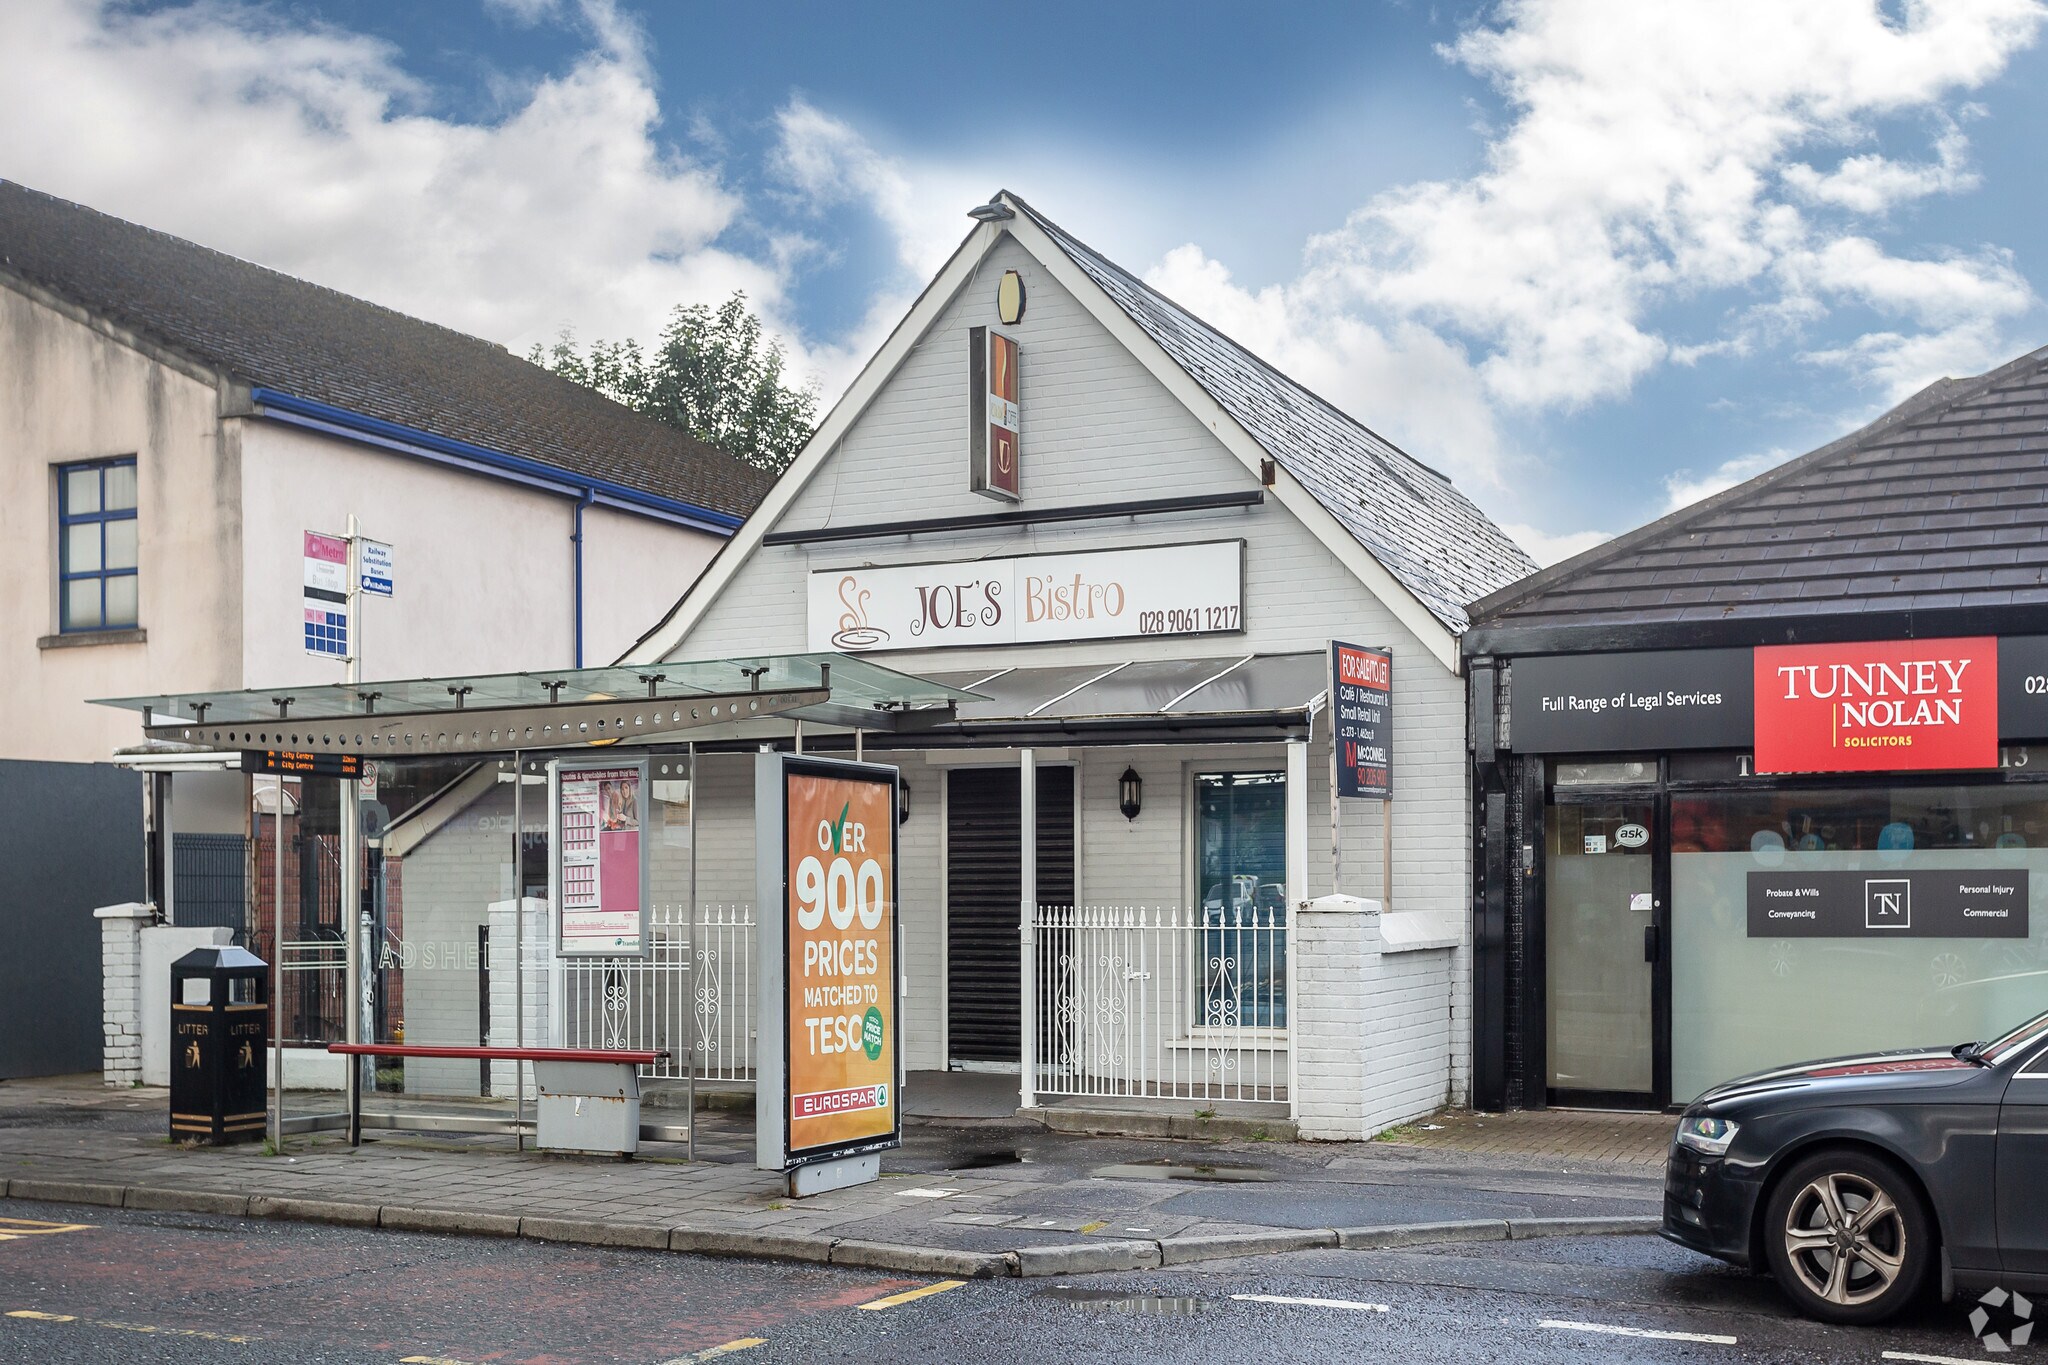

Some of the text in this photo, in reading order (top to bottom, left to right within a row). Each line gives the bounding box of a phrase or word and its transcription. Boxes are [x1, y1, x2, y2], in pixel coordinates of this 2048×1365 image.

[322, 545, 344, 560] Metro
[368, 547, 386, 558] Railway
[363, 556, 391, 568] Substitution
[370, 567, 384, 576] Buses
[910, 573, 1125, 637] JOE'S Bistro
[1139, 605, 1239, 634] 028 9061 1217
[1342, 654, 1356, 678] FOR
[1379, 662, 1387, 684] LET
[1777, 659, 1971, 699] TUNNEY
[2025, 675, 2048, 694] 02
[1340, 685, 1355, 701] Café
[1360, 689, 1384, 706] Restaurant
[1542, 691, 1722, 713] Full Range of Legal Services
[1341, 705, 1380, 723] Small Retail Unit
[1842, 699, 1962, 728] NOLAN
[1844, 735, 1912, 747] SOLICITORS
[282, 750, 294, 760] City
[295, 751, 313, 760] Centre
[282, 760, 294, 770] City
[295, 761, 314, 770] Centre
[607, 770, 618, 778] from
[1620, 828, 1643, 839] ask
[796, 856, 884, 930] 900
[1766, 888, 1819, 897] Probate & Wills
[1959, 885, 2014, 895] Personal Injury
[1768, 910, 1816, 919] Conveyancing
[1963, 908, 2009, 918] Commercial
[379, 941, 499, 970] ADSHEL
[804, 939, 878, 977] PRICES
[804, 984, 878, 1008] MATCHED TO
[178, 1024, 208, 1035] LITTER
[231, 1024, 260, 1035] LITTER
[865, 1021, 881, 1036] PRICE
[863, 1031, 882, 1047] MATCH
[804, 1088, 876, 1113] EUROSPAR
